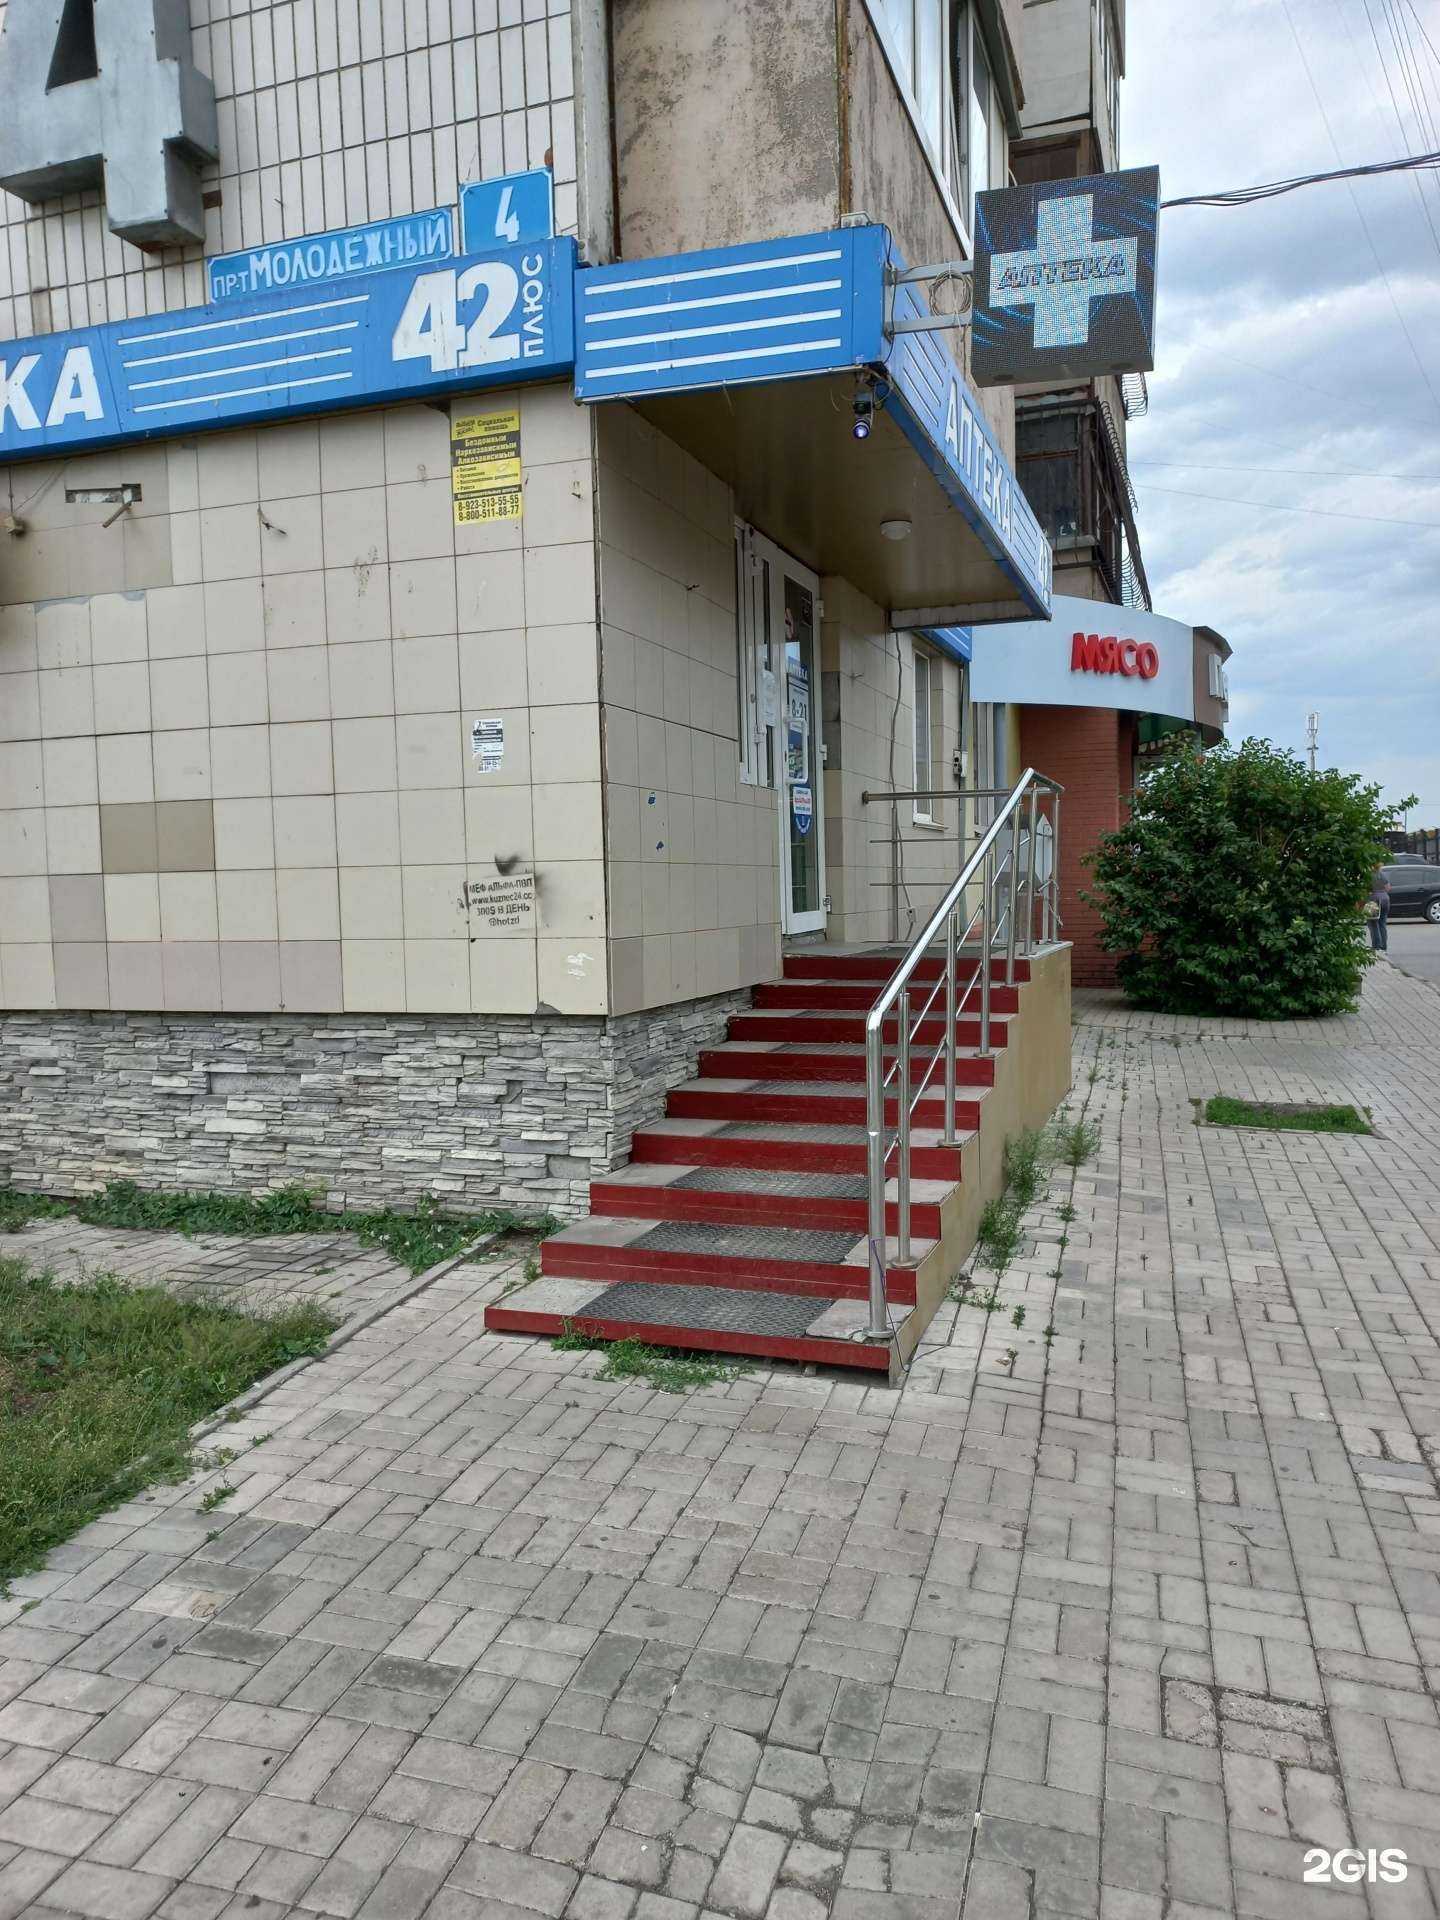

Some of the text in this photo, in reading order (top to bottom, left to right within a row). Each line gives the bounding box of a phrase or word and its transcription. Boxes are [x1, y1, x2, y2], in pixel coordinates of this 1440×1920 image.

[495, 186, 520, 243] 4
[997, 252, 1126, 290] АПТЕКА
[392, 261, 520, 373] 42
[521, 253, 545, 358] ПЛЮС
[944, 376, 1013, 542] АПТЕКА
[1071, 632, 1160, 680] МЯСО
[506, 902, 530, 914] ДЕНЬ
